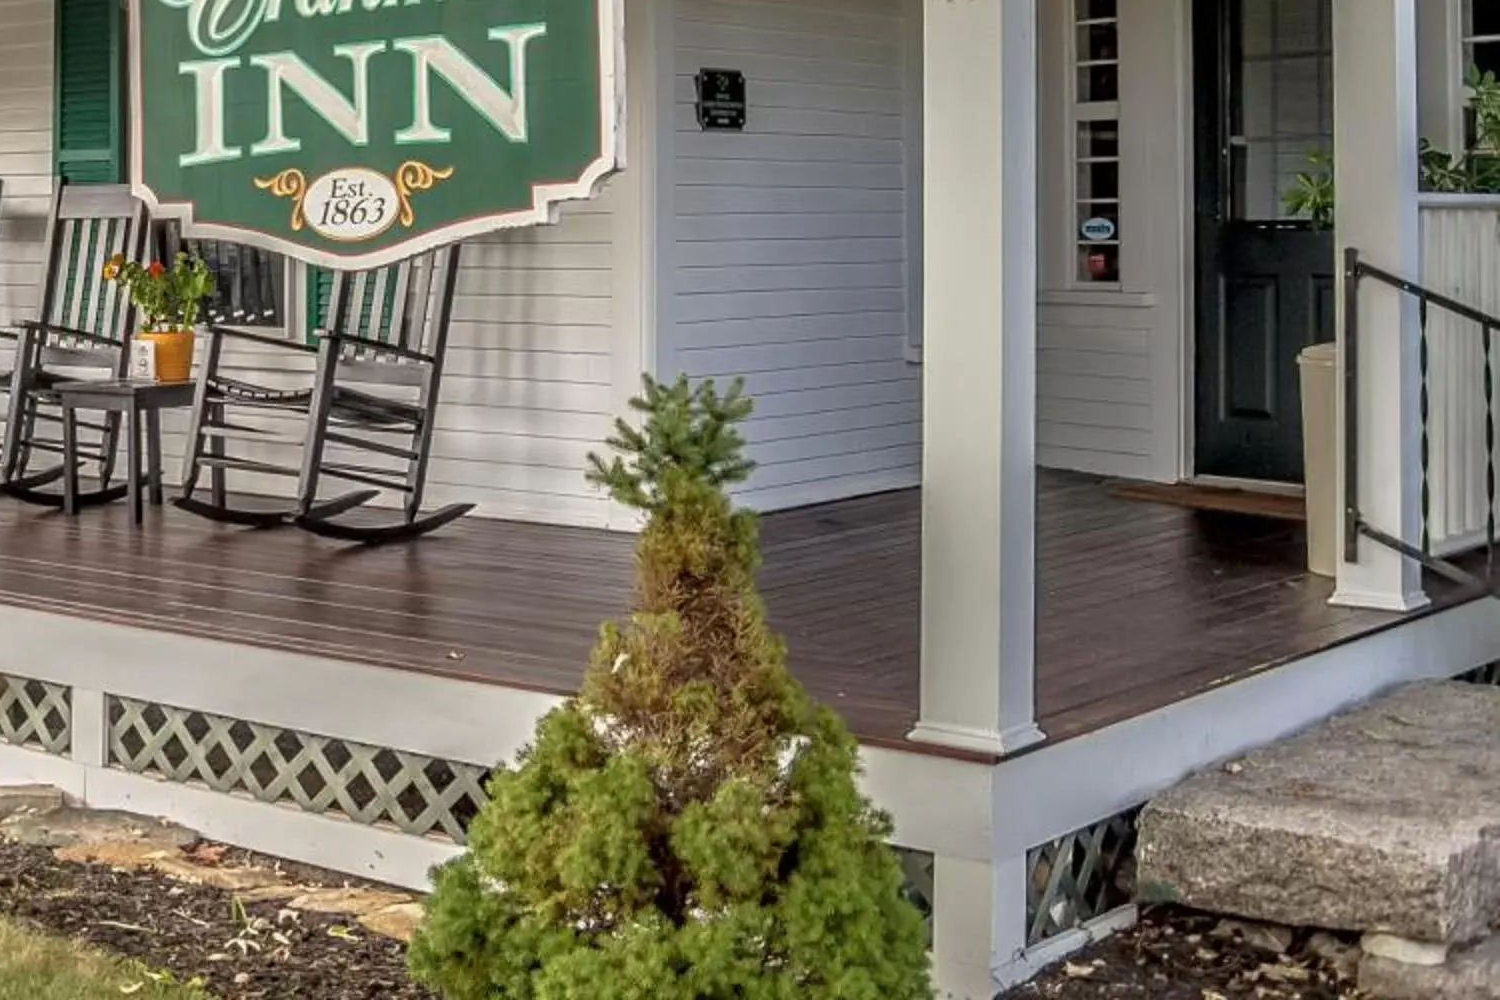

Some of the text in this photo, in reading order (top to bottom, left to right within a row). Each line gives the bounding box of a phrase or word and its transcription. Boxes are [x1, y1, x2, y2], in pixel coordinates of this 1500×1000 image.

[179, 23, 546, 167] INN
[331, 178, 373, 198] Est.
[319, 197, 385, 225] 1863
